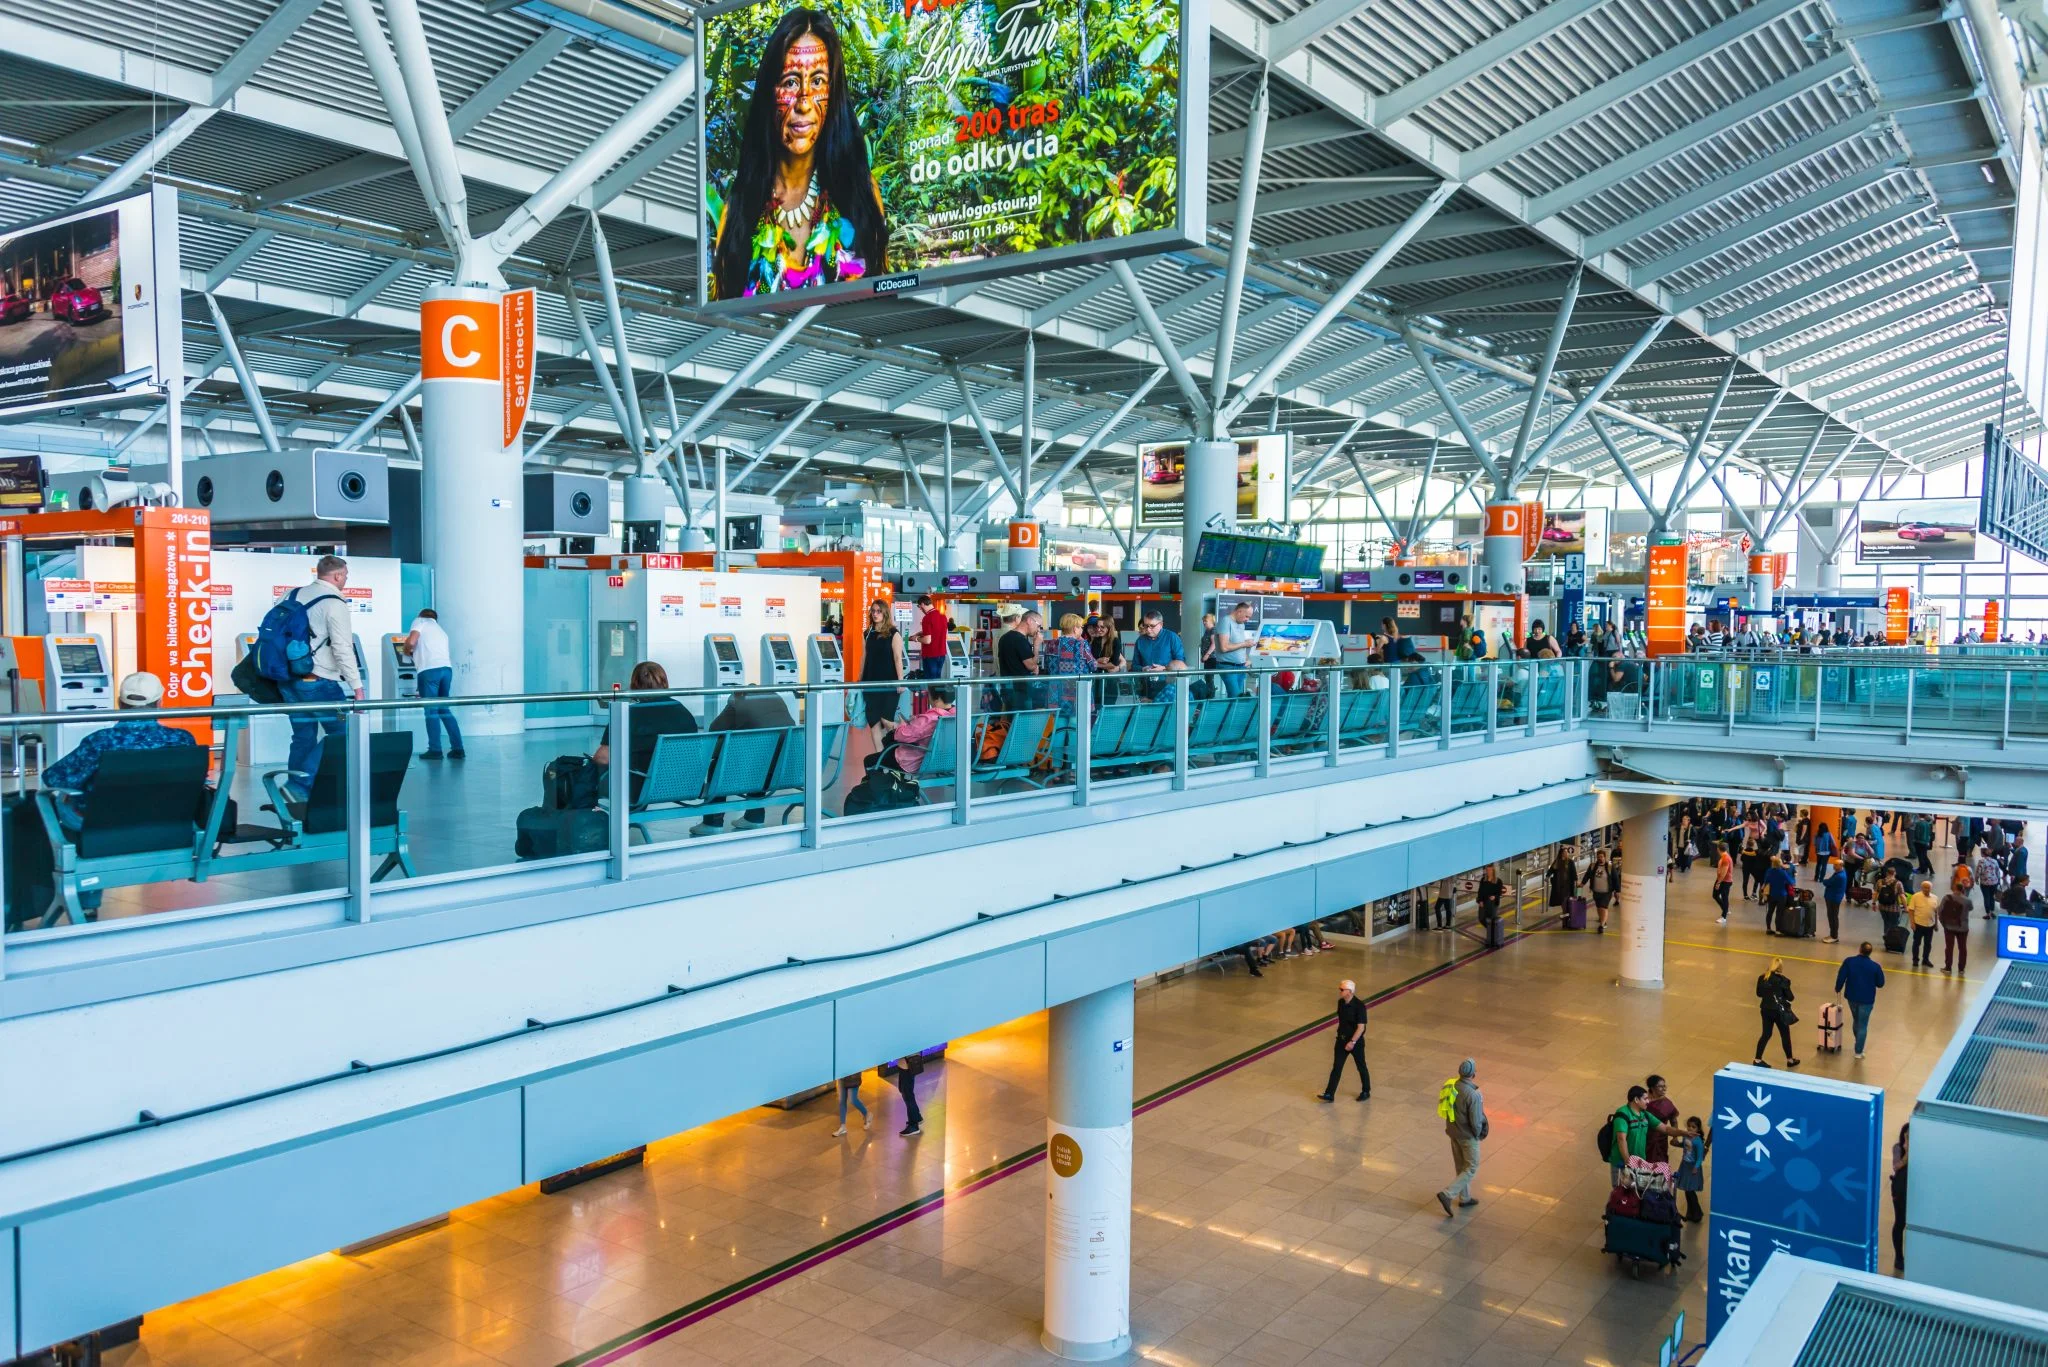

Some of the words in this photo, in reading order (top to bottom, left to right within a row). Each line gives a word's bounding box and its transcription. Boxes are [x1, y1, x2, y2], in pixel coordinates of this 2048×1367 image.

[907, 19, 992, 93] Logos
[986, 0, 1059, 65] Tour
[983, 69, 1000, 79] BIURO
[1001, 61, 1030, 75] TURYSTYKI
[909, 128, 951, 155] ponad
[954, 107, 1002, 143] 200
[1008, 100, 1060, 131] tras
[909, 155, 941, 184] do
[947, 130, 1060, 176] odkrycia
[927, 189, 1042, 225] www.logostour.pl
[951, 227, 970, 242] 801
[973, 224, 992, 238] 011
[995, 220, 1015, 235] 864
[875, 277, 918, 293] JCDecaux
[441, 314, 481, 368] C
[514, 295, 525, 369] check-in
[514, 373, 525, 408] Self
[171, 513, 208, 526] 201-210
[1018, 526, 1032, 544] D
[1502, 509, 1519, 531] D
[1761, 557, 1771, 571] E
[47, 581, 60, 589] Self
[61, 581, 91, 589] Check-in
[164, 544, 179, 648] biletowo-bagażowa
[179, 529, 213, 699] Check-in
